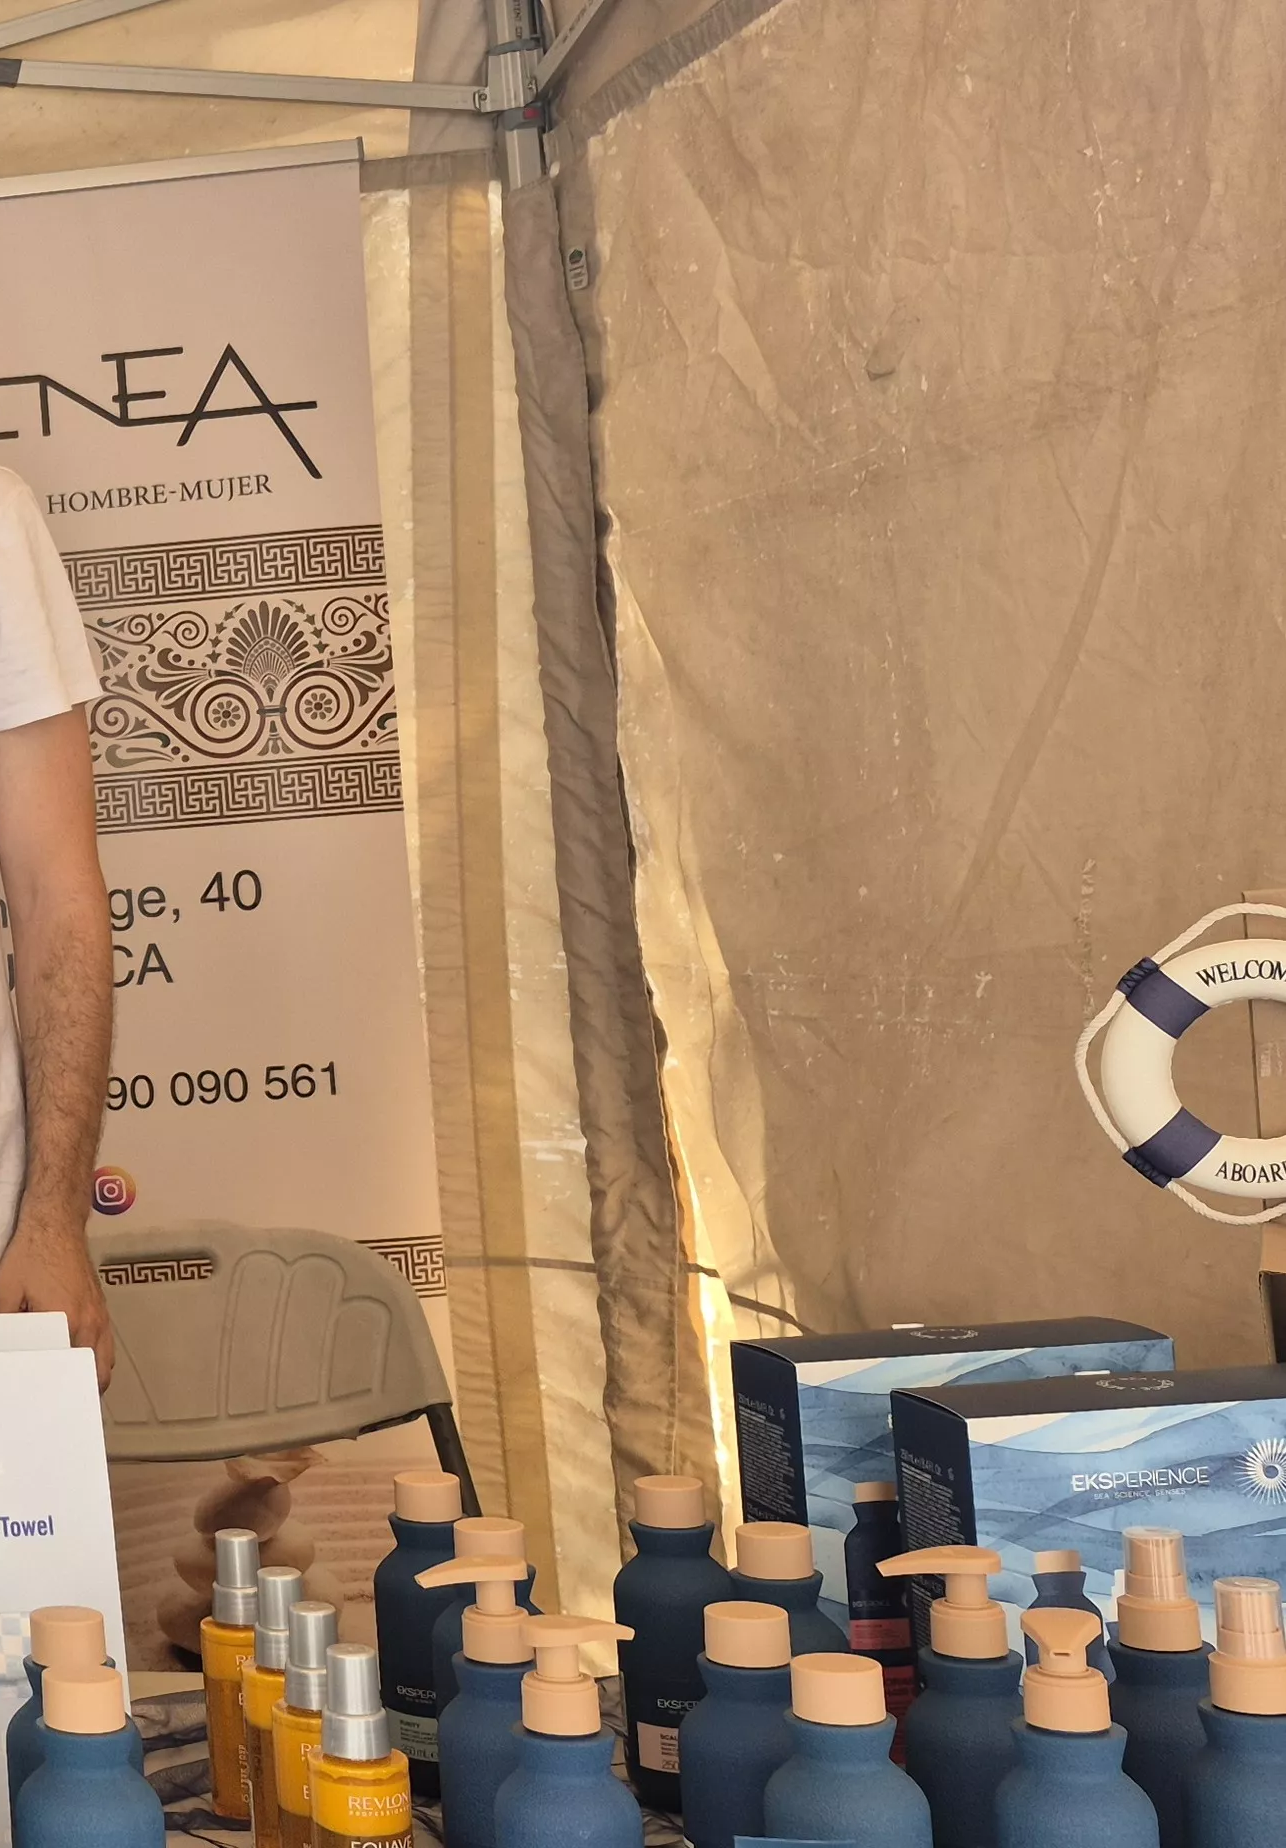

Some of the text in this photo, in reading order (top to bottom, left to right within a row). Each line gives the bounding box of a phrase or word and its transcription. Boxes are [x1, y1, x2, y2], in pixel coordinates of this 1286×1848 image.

[46, 474, 273, 514] HOMBRE-MUJER
[108, 870, 262, 931] ge, 40
[1196, 959, 1286, 988] WELCOM
[107, 1060, 338, 1111] 90 090 561
[1071, 1466, 1210, 1492] EKSPERIENCE
[0, 1515, 55, 1538] Towel
[396, 1685, 436, 1700] EKSPERI
[348, 1790, 410, 1811] REVLON
